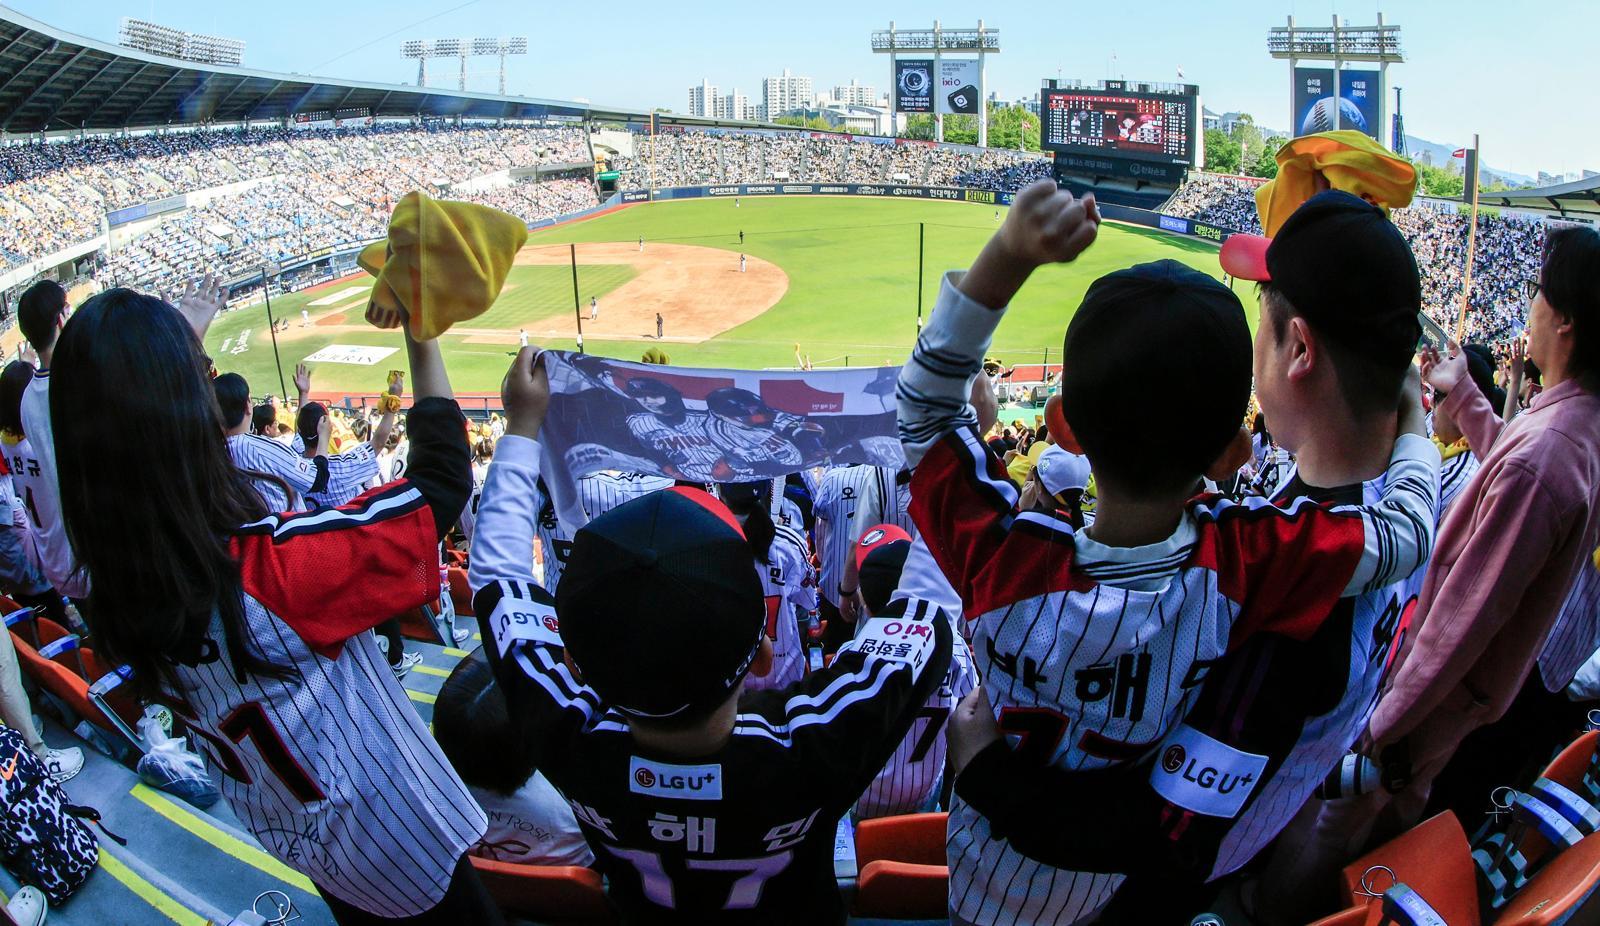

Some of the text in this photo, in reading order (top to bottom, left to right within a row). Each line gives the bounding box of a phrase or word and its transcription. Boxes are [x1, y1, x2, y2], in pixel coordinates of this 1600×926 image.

[1306, 78, 1321, 86] 승리를
[930, 187, 958, 199] 현대해상
[967, 190, 992, 202] REUZEL
[1194, 224, 1222, 240] 대방건설
[859, 639, 912, 658] 통화앱
[601, 842, 795, 910] 17
